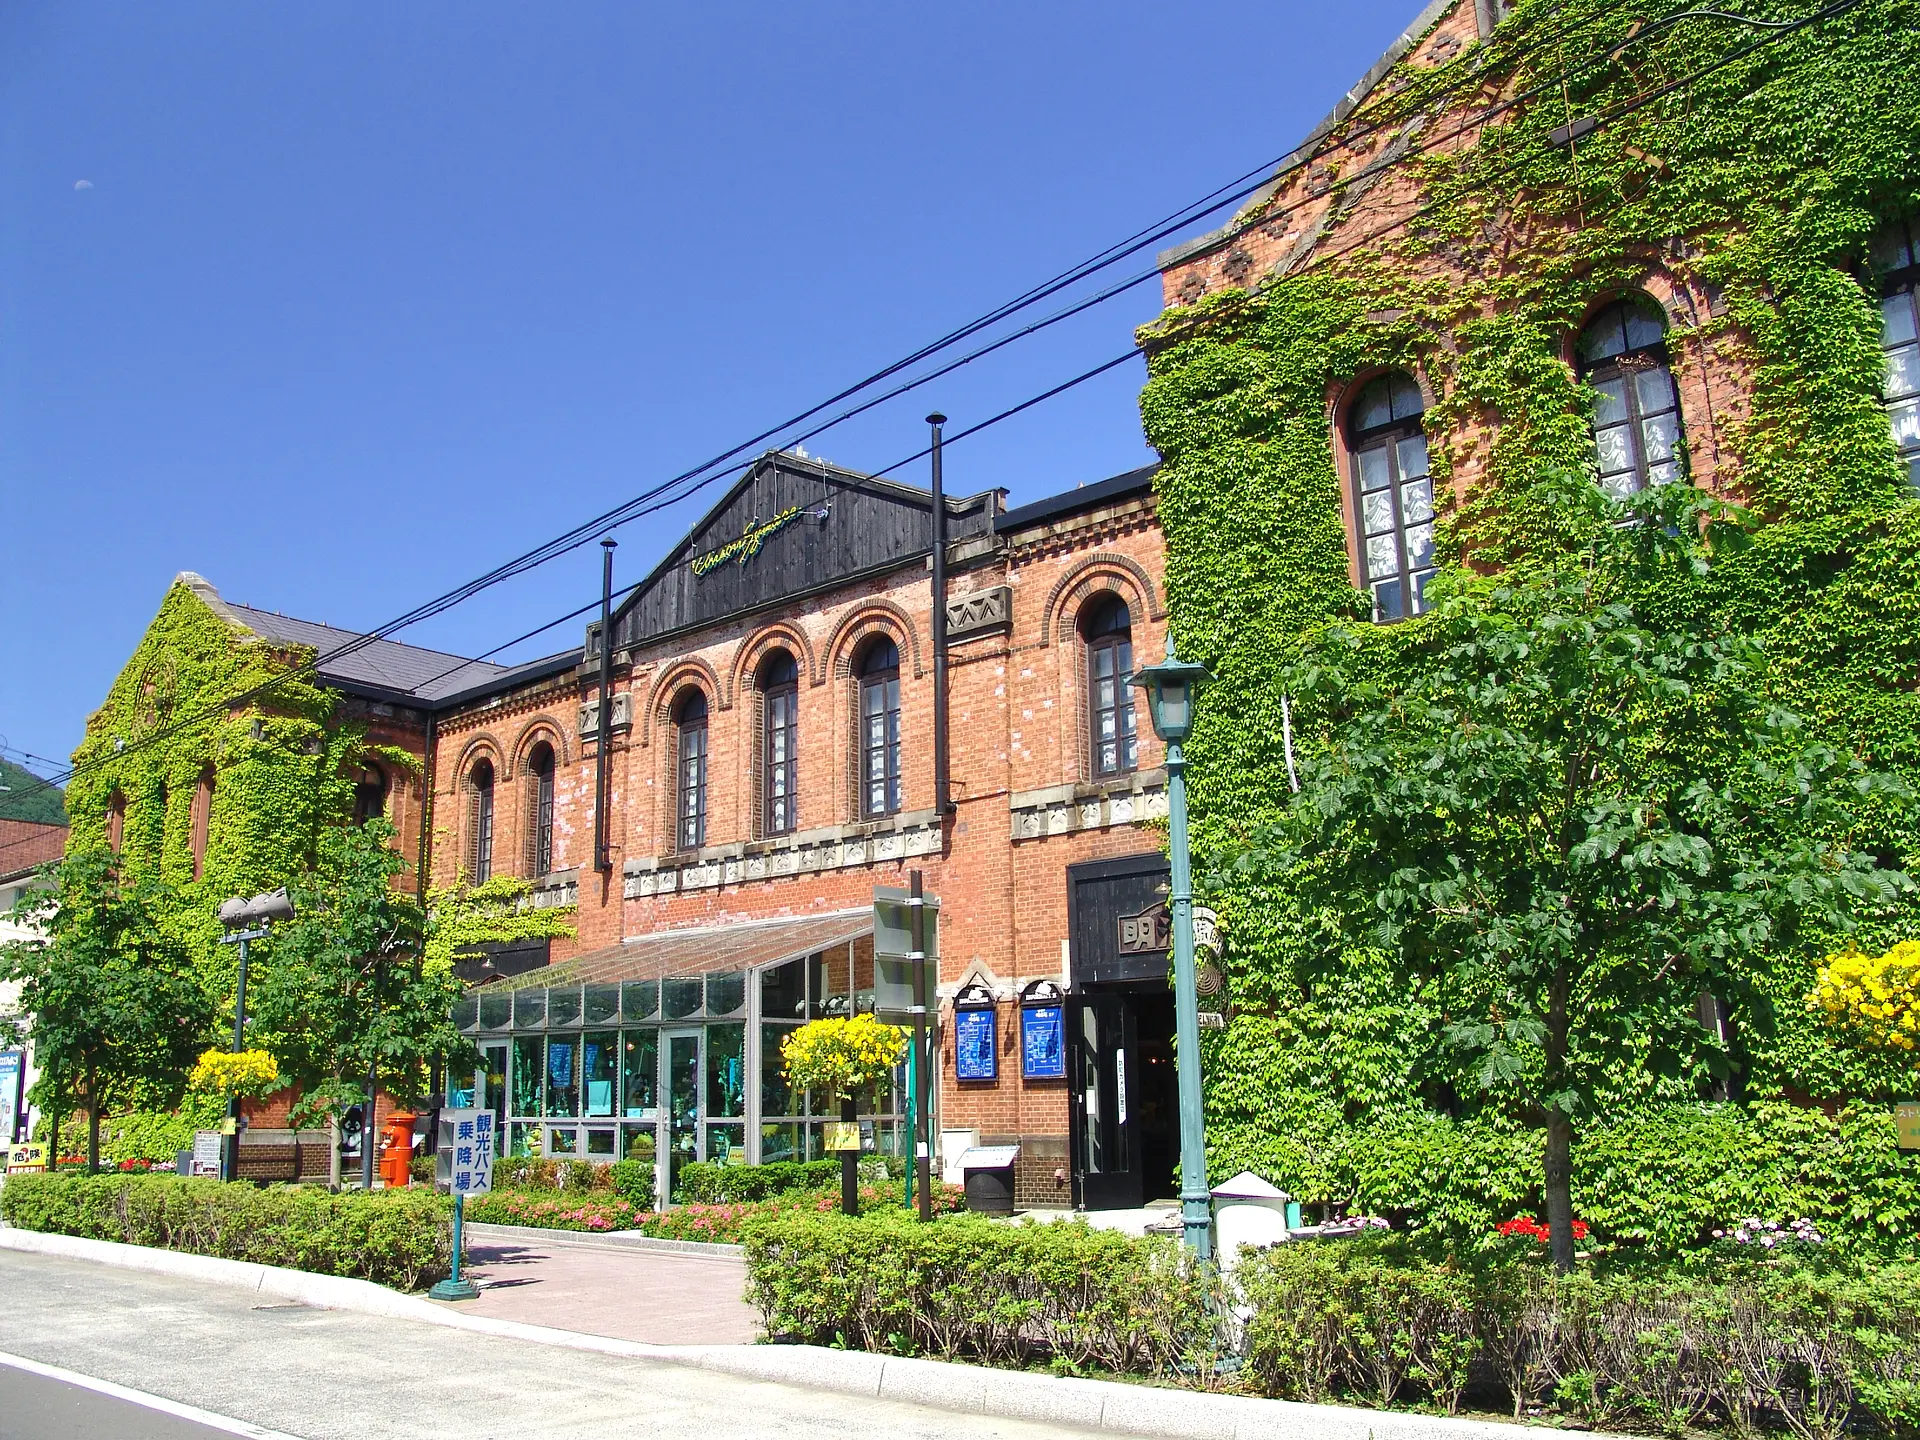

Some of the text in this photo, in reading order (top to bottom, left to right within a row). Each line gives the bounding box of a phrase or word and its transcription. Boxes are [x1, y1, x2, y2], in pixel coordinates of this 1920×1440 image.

[14, 1148, 41, 1162] 危険
[455, 1121, 474, 1191] 乗降場
[473, 1114, 492, 1189] 観光バス
